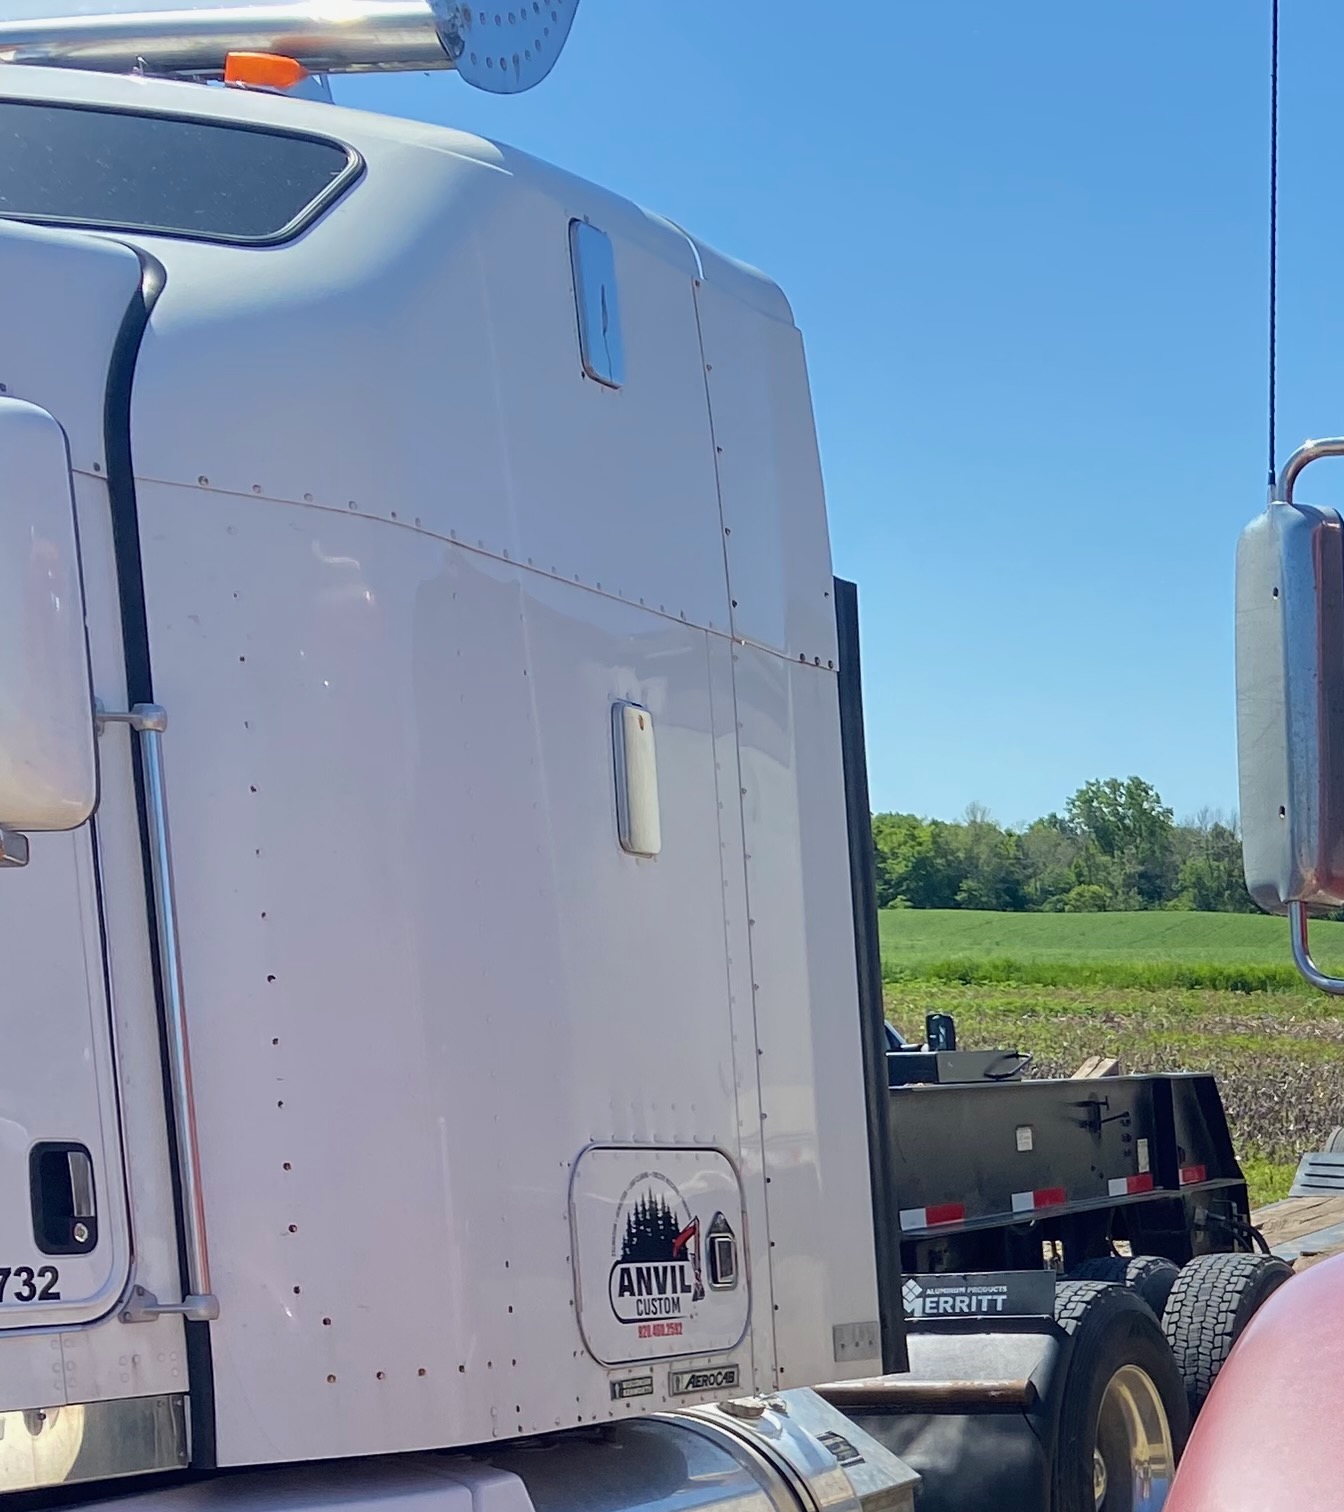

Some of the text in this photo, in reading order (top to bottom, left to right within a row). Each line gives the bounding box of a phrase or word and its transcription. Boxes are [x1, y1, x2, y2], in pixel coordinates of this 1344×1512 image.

[618, 1264, 692, 1298] ANVIL
[967, 1285, 1008, 1293] PRODUCTS
[636, 1297, 681, 1316] CUSTOM
[903, 1294, 1008, 1317] MERRITT
[684, 1371, 735, 1390] AEROCAB
